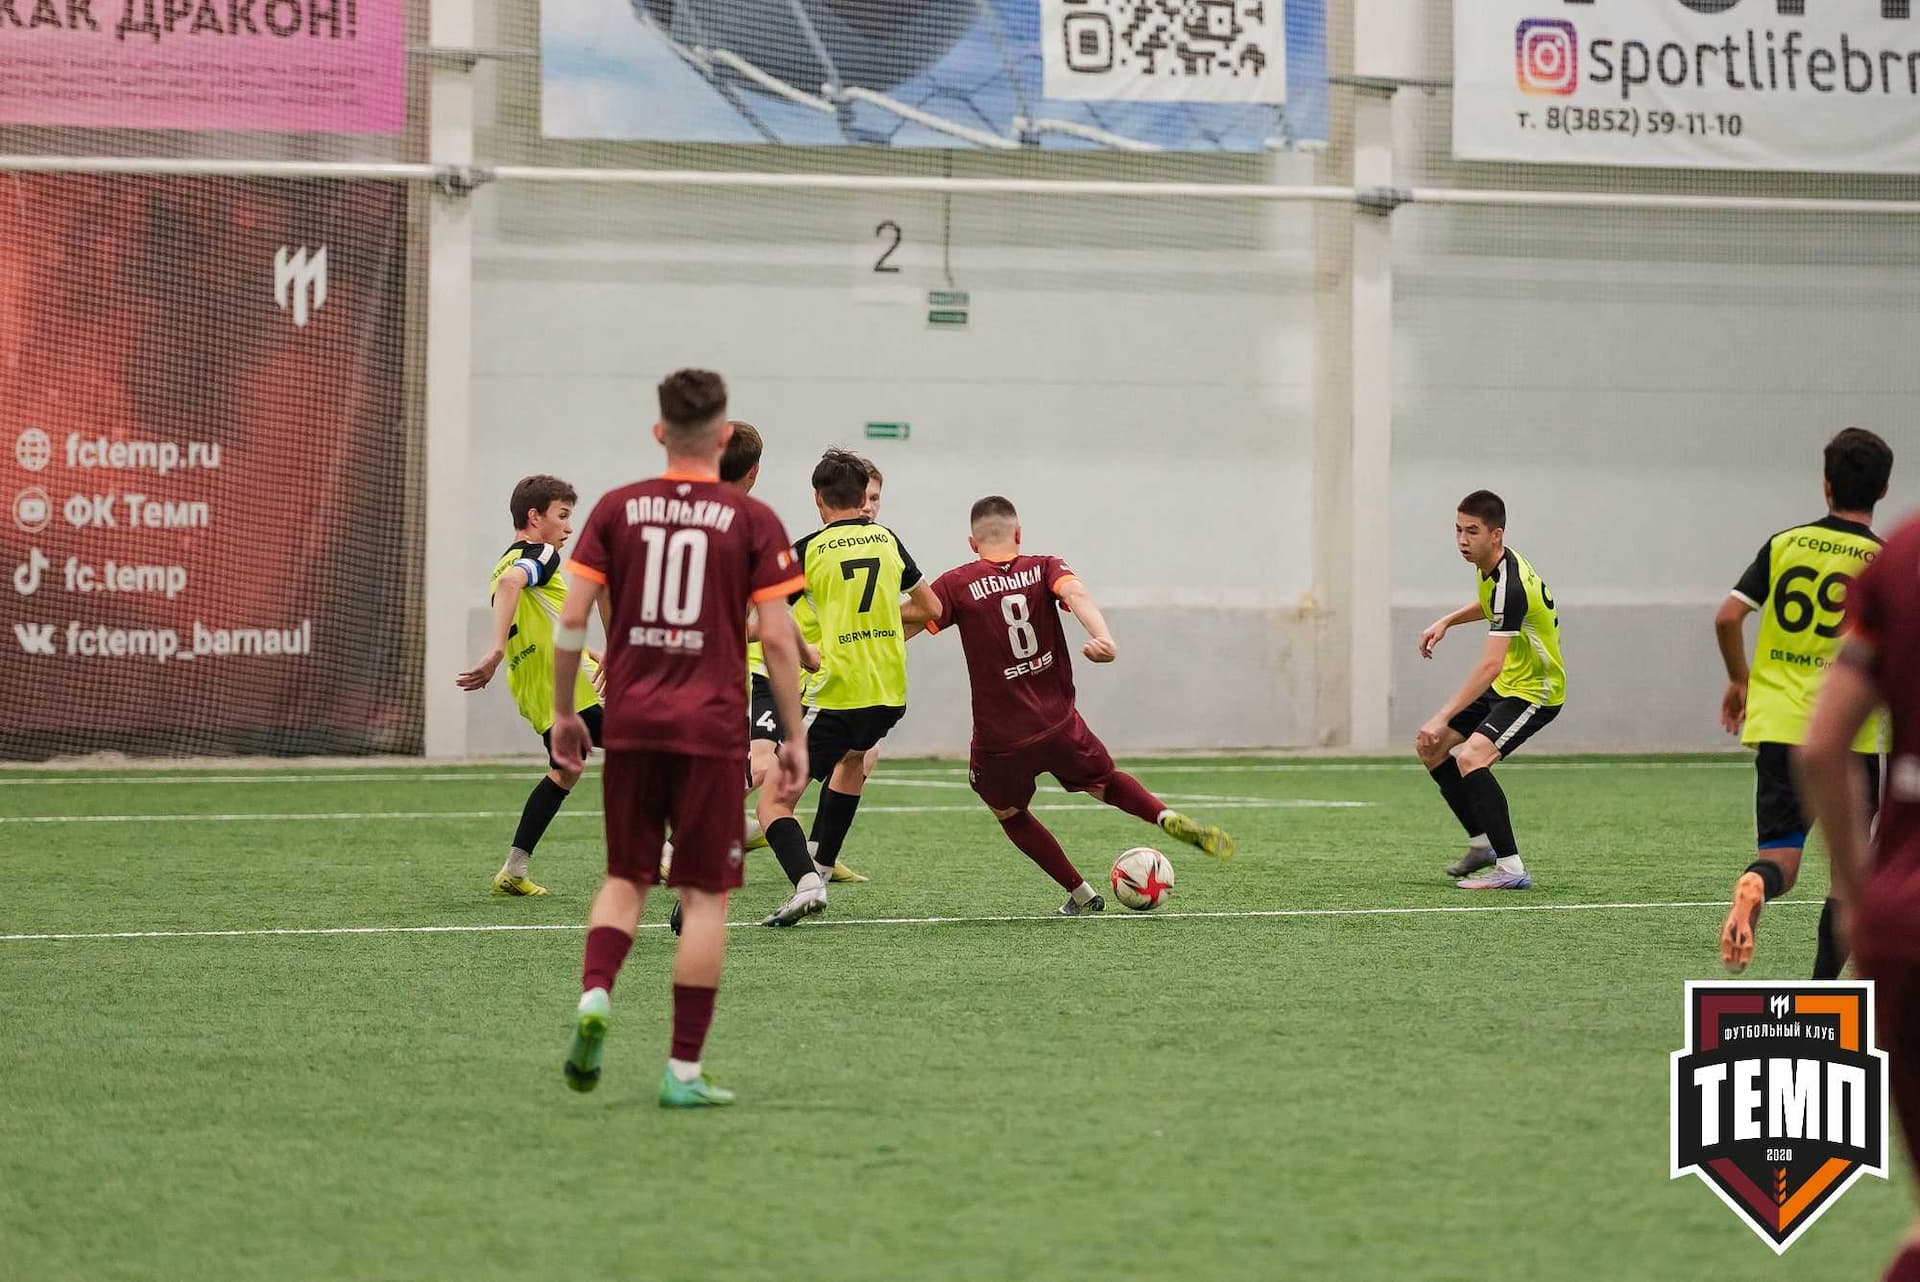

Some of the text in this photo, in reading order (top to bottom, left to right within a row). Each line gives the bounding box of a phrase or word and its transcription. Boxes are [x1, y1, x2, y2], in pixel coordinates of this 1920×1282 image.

[115, 0, 357, 42] ДРАКОН!
[1546, 106, 1639, 136] 8(3852)
[1647, 110, 1742, 137] 59-11-10
[873, 219, 902, 273] 2
[65, 432, 221, 476] fctemp.ru
[64, 493, 209, 529] ФК Темп
[64, 556, 187, 600] fc.temp
[641, 526, 708, 626] 10
[840, 557, 881, 614] 7
[1774, 565, 1854, 639] 69
[65, 618, 311, 664] fctemp_barnaul
[1001, 593, 1039, 660] 8
[1003, 650, 1054, 680] SEUS
[756, 710, 777, 732] 4
